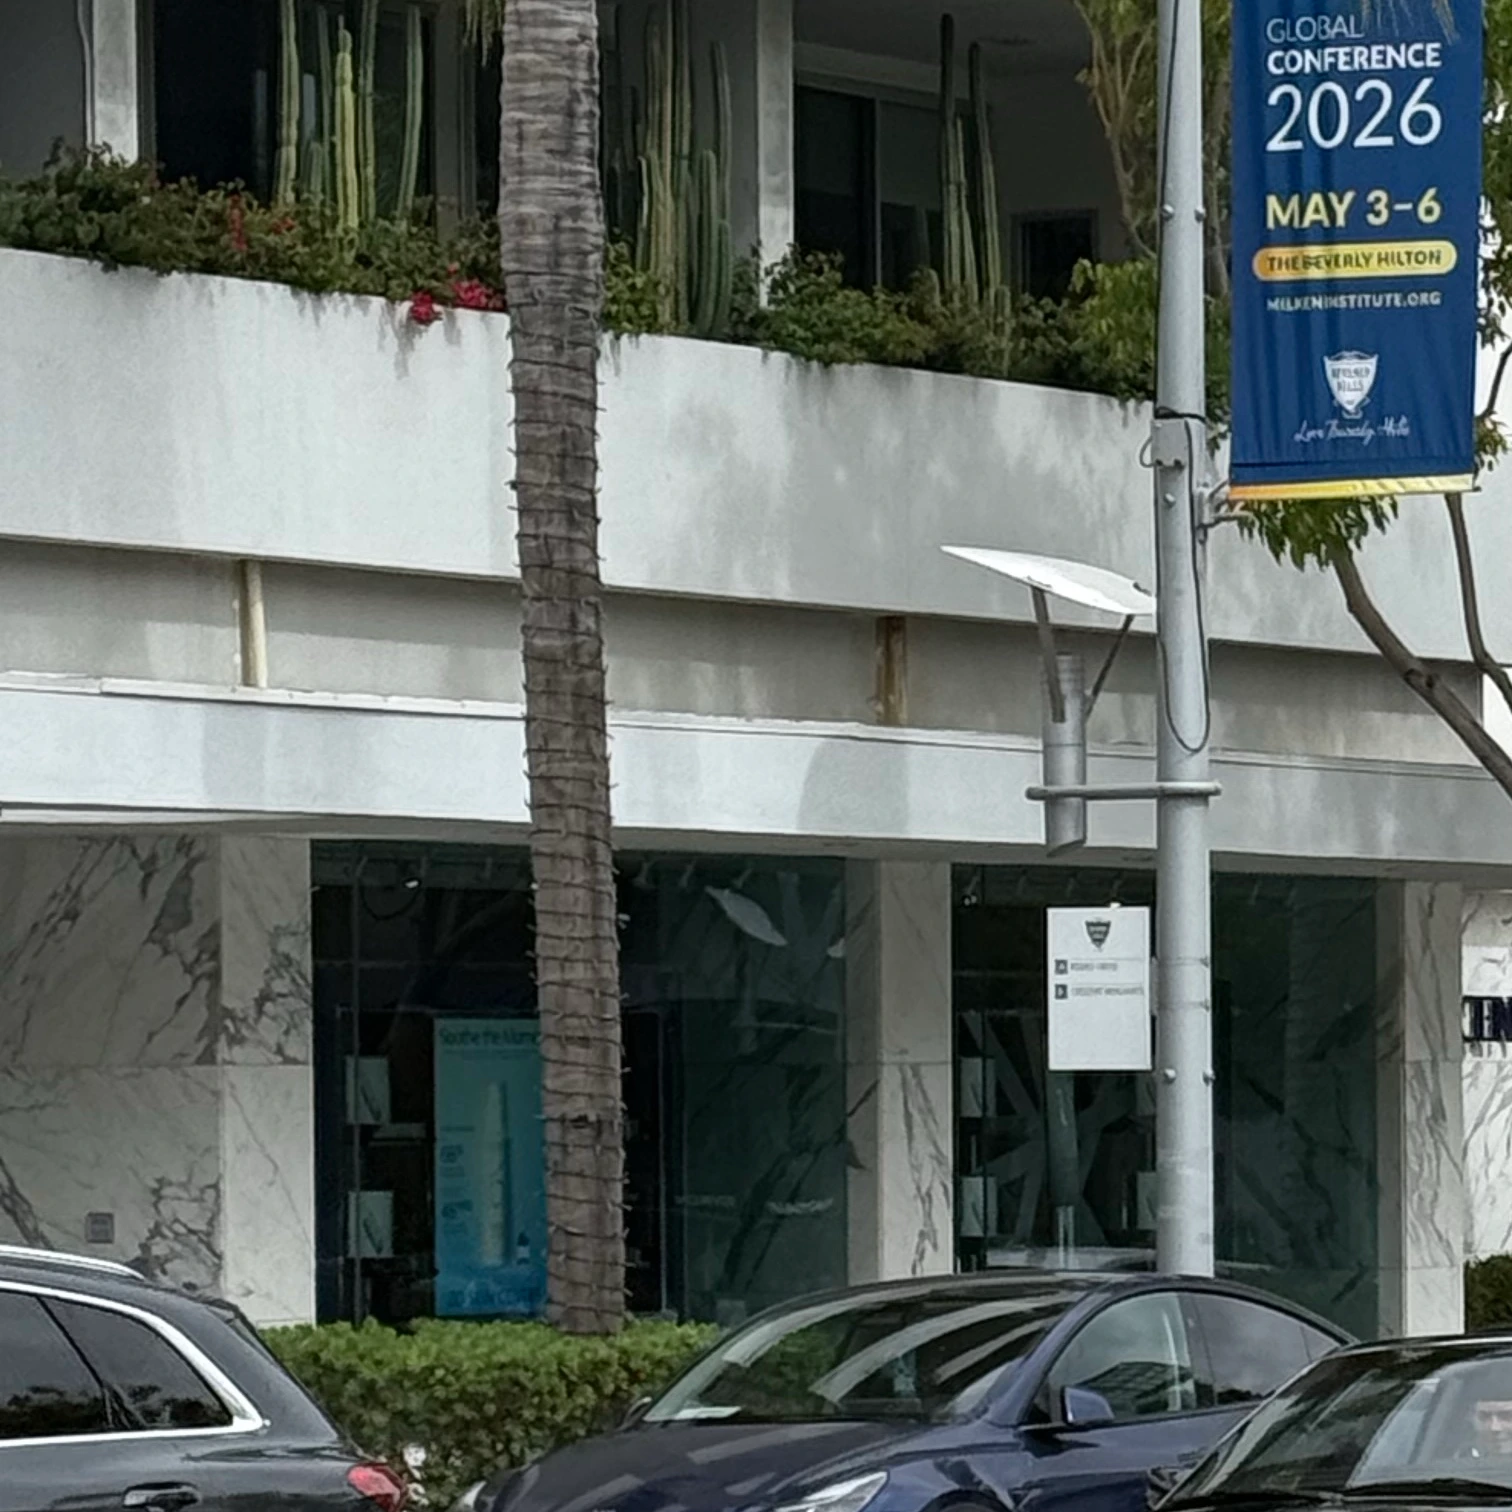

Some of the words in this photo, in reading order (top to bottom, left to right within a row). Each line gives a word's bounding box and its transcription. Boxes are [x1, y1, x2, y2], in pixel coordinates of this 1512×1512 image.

[1266, 14, 1365, 43] GLOBAL
[1267, 42, 1442, 74] CONFERENCE
[1266, 77, 1442, 151] 2026
[1266, 190, 1356, 230] MAY
[1366, 187, 1441, 226] 3-6
[1267, 254, 1298, 271] THE
[1302, 251, 1372, 271] BEVERLY
[1376, 248, 1442, 267] HILTON
[1267, 291, 1442, 312] MILKENINSTITUTE.ORG
